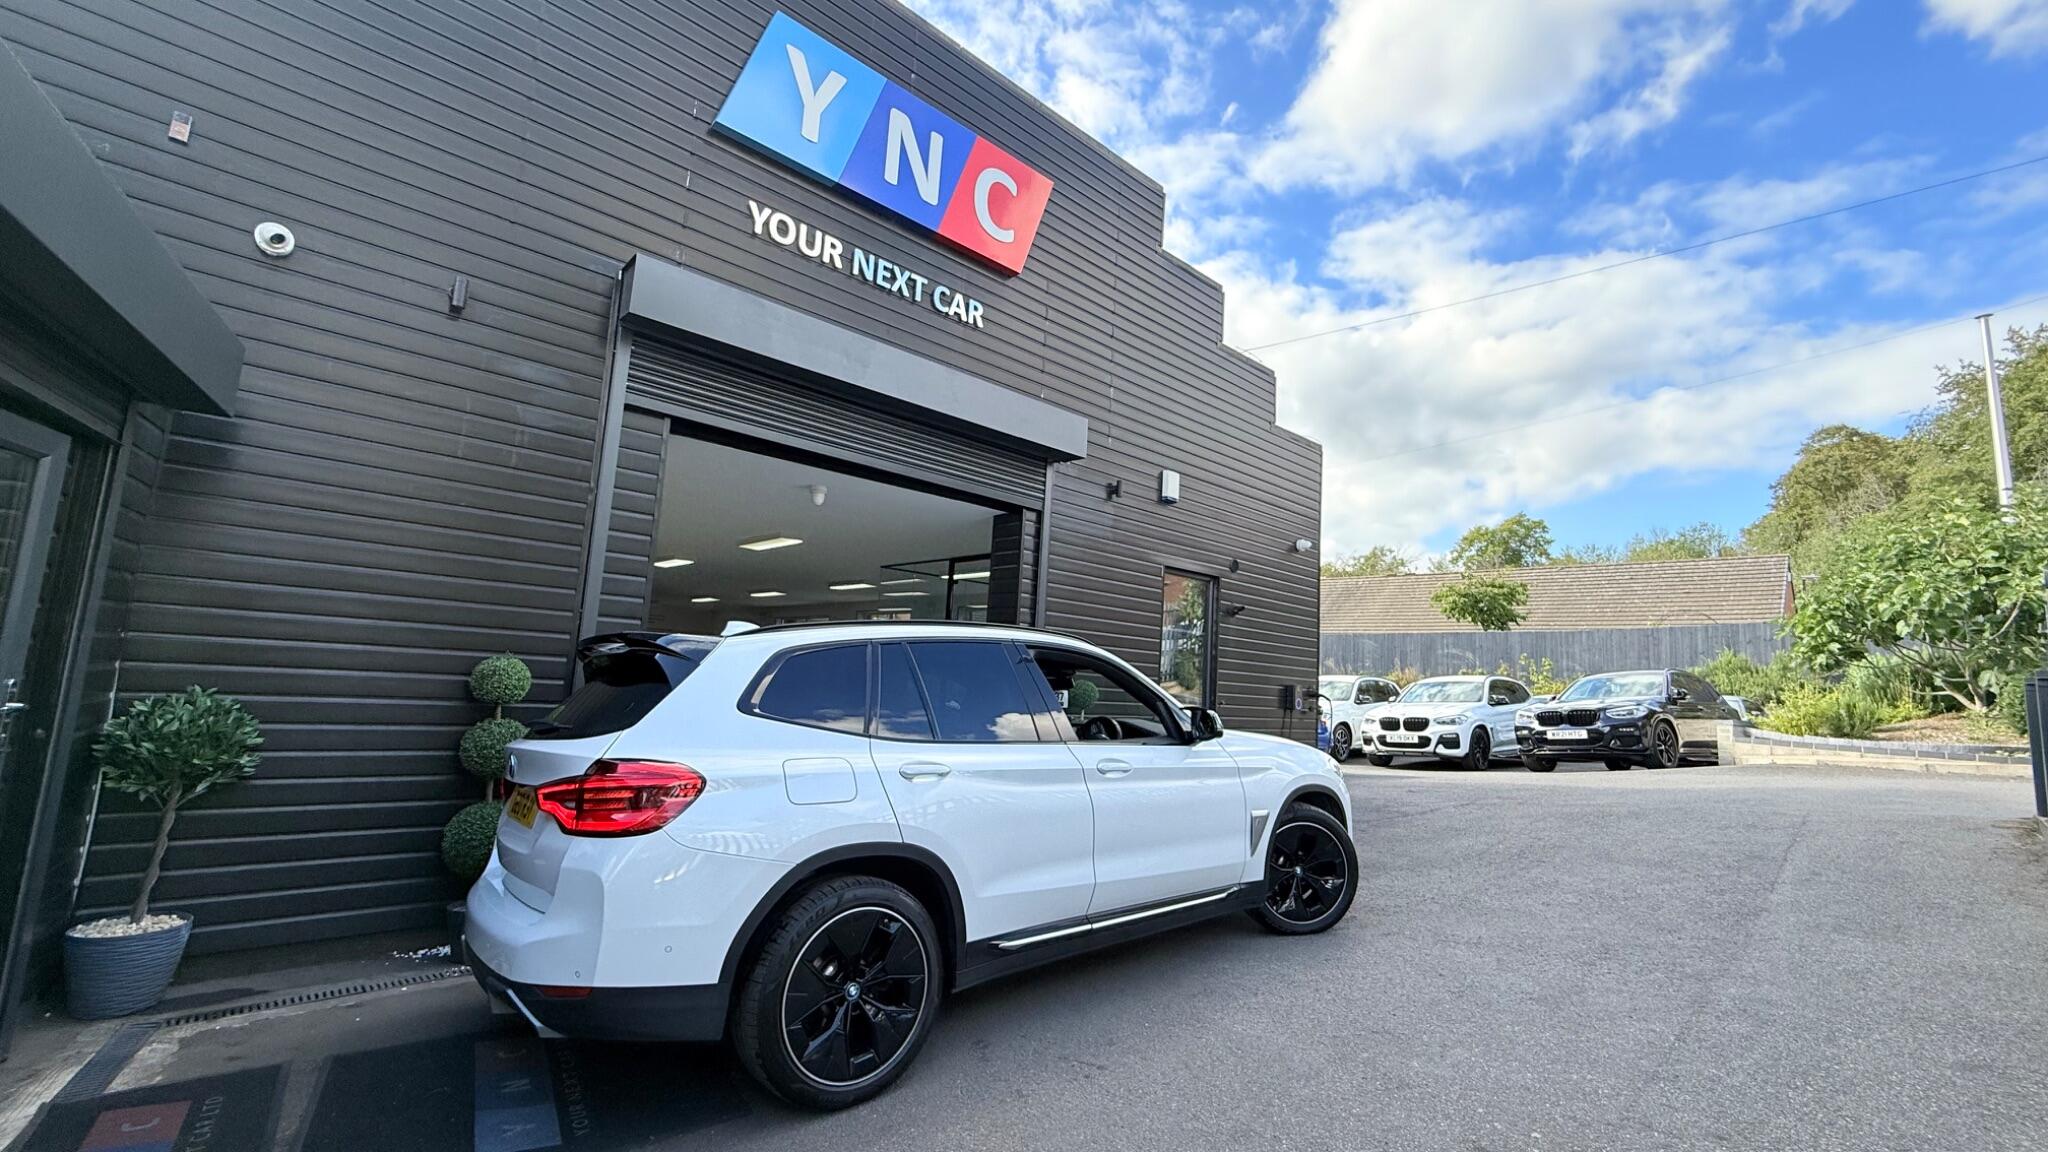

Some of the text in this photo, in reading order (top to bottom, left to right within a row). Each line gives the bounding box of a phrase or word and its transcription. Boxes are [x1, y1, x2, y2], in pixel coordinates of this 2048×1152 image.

[786, 44, 1018, 243] YNC
[749, 200, 985, 328] YOUR NEXT CAR
